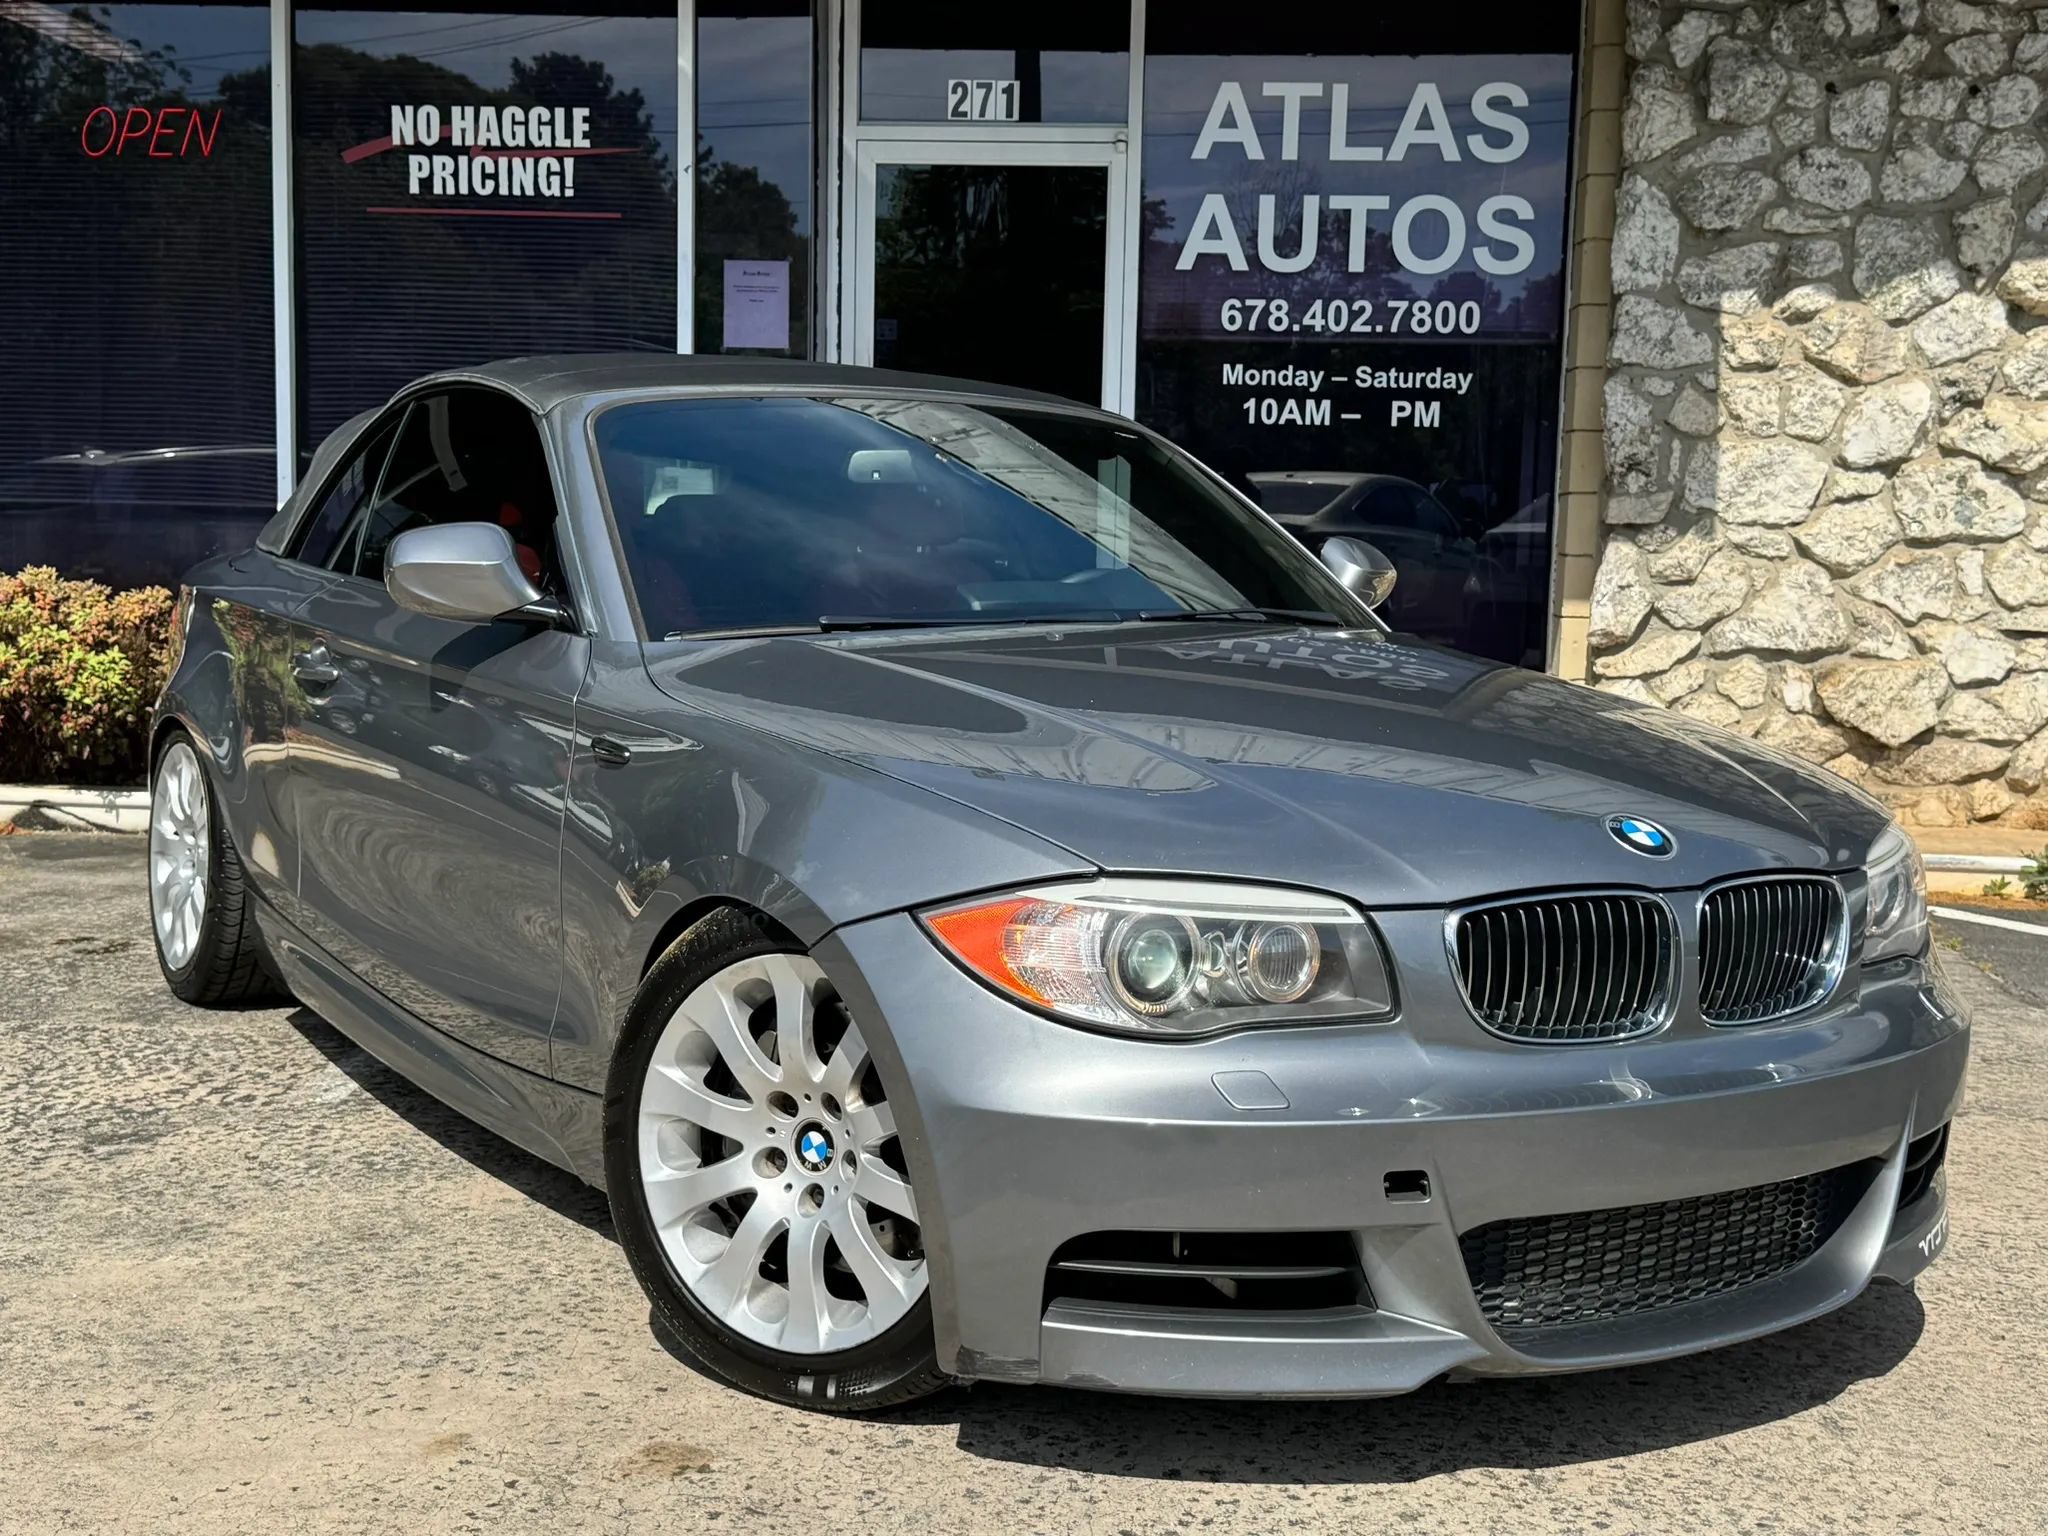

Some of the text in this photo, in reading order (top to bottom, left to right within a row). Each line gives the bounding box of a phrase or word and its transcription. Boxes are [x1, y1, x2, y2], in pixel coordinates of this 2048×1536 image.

[950, 81, 1016, 119] 271
[81, 106, 222, 158] OPEN
[391, 104, 592, 149] NO HAGGLE
[1190, 81, 1530, 164] ATLAS
[408, 154, 575, 198] PRICING!
[1175, 193, 1536, 275] AUTOS
[1220, 298, 1481, 335] 678.402.7800
[1222, 363, 1325, 393] Monday
[1354, 365, 1473, 395] Saturday
[1243, 397, 1331, 426] 10AM
[1390, 400, 1441, 428] PM
